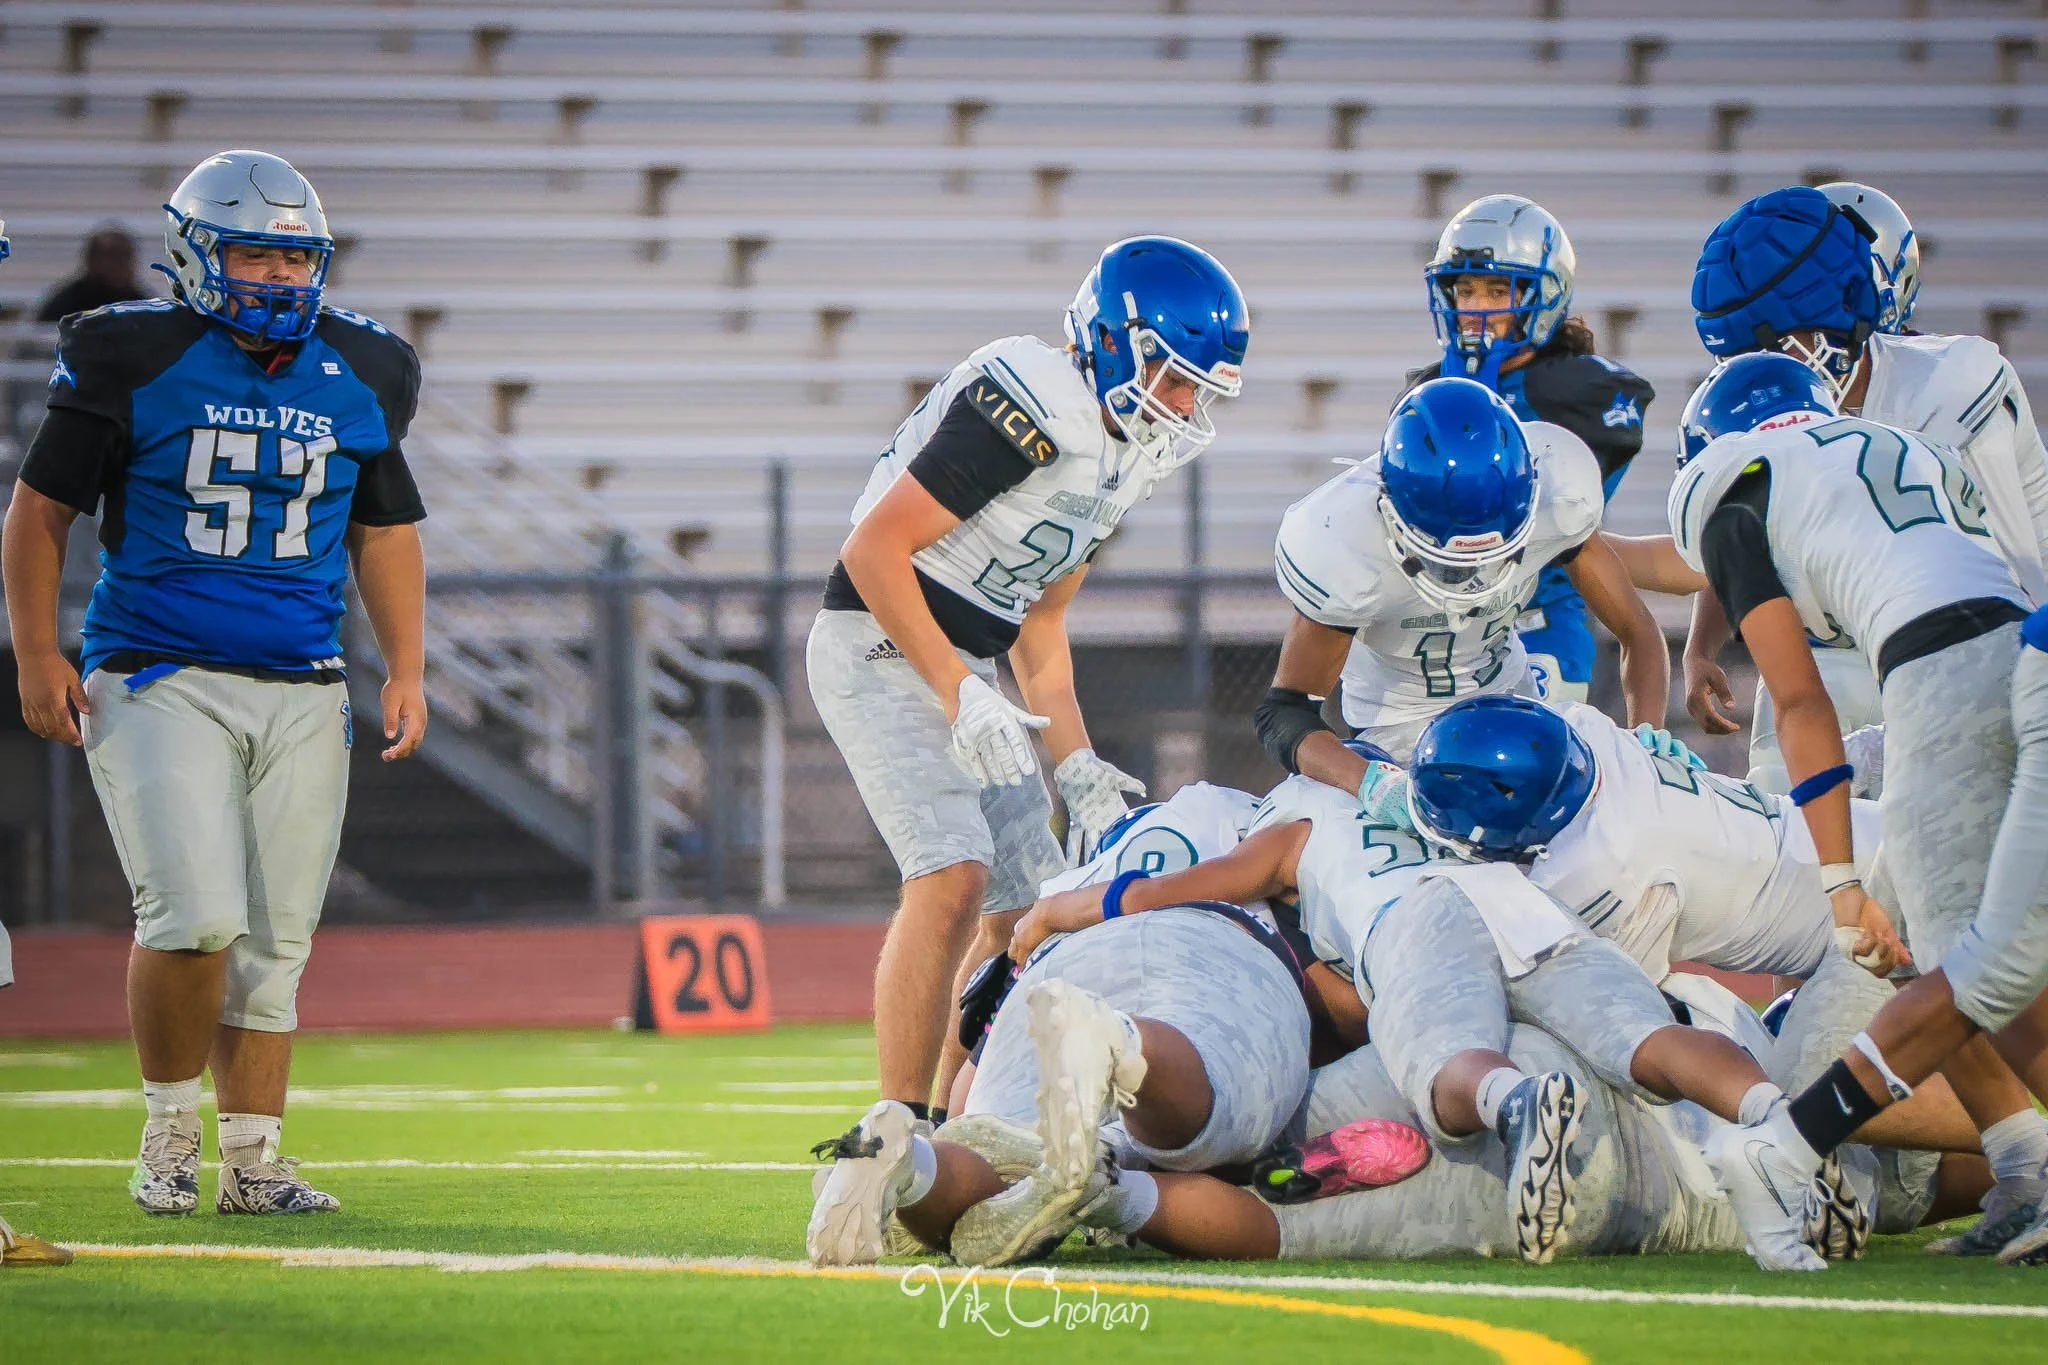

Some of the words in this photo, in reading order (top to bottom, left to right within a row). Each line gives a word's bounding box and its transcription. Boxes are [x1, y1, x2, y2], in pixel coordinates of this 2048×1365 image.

[204, 404, 333, 437] WOLVES
[976, 385, 1053, 462] VICIS
[184, 426, 339, 561] 57
[667, 933, 753, 1013] 20
